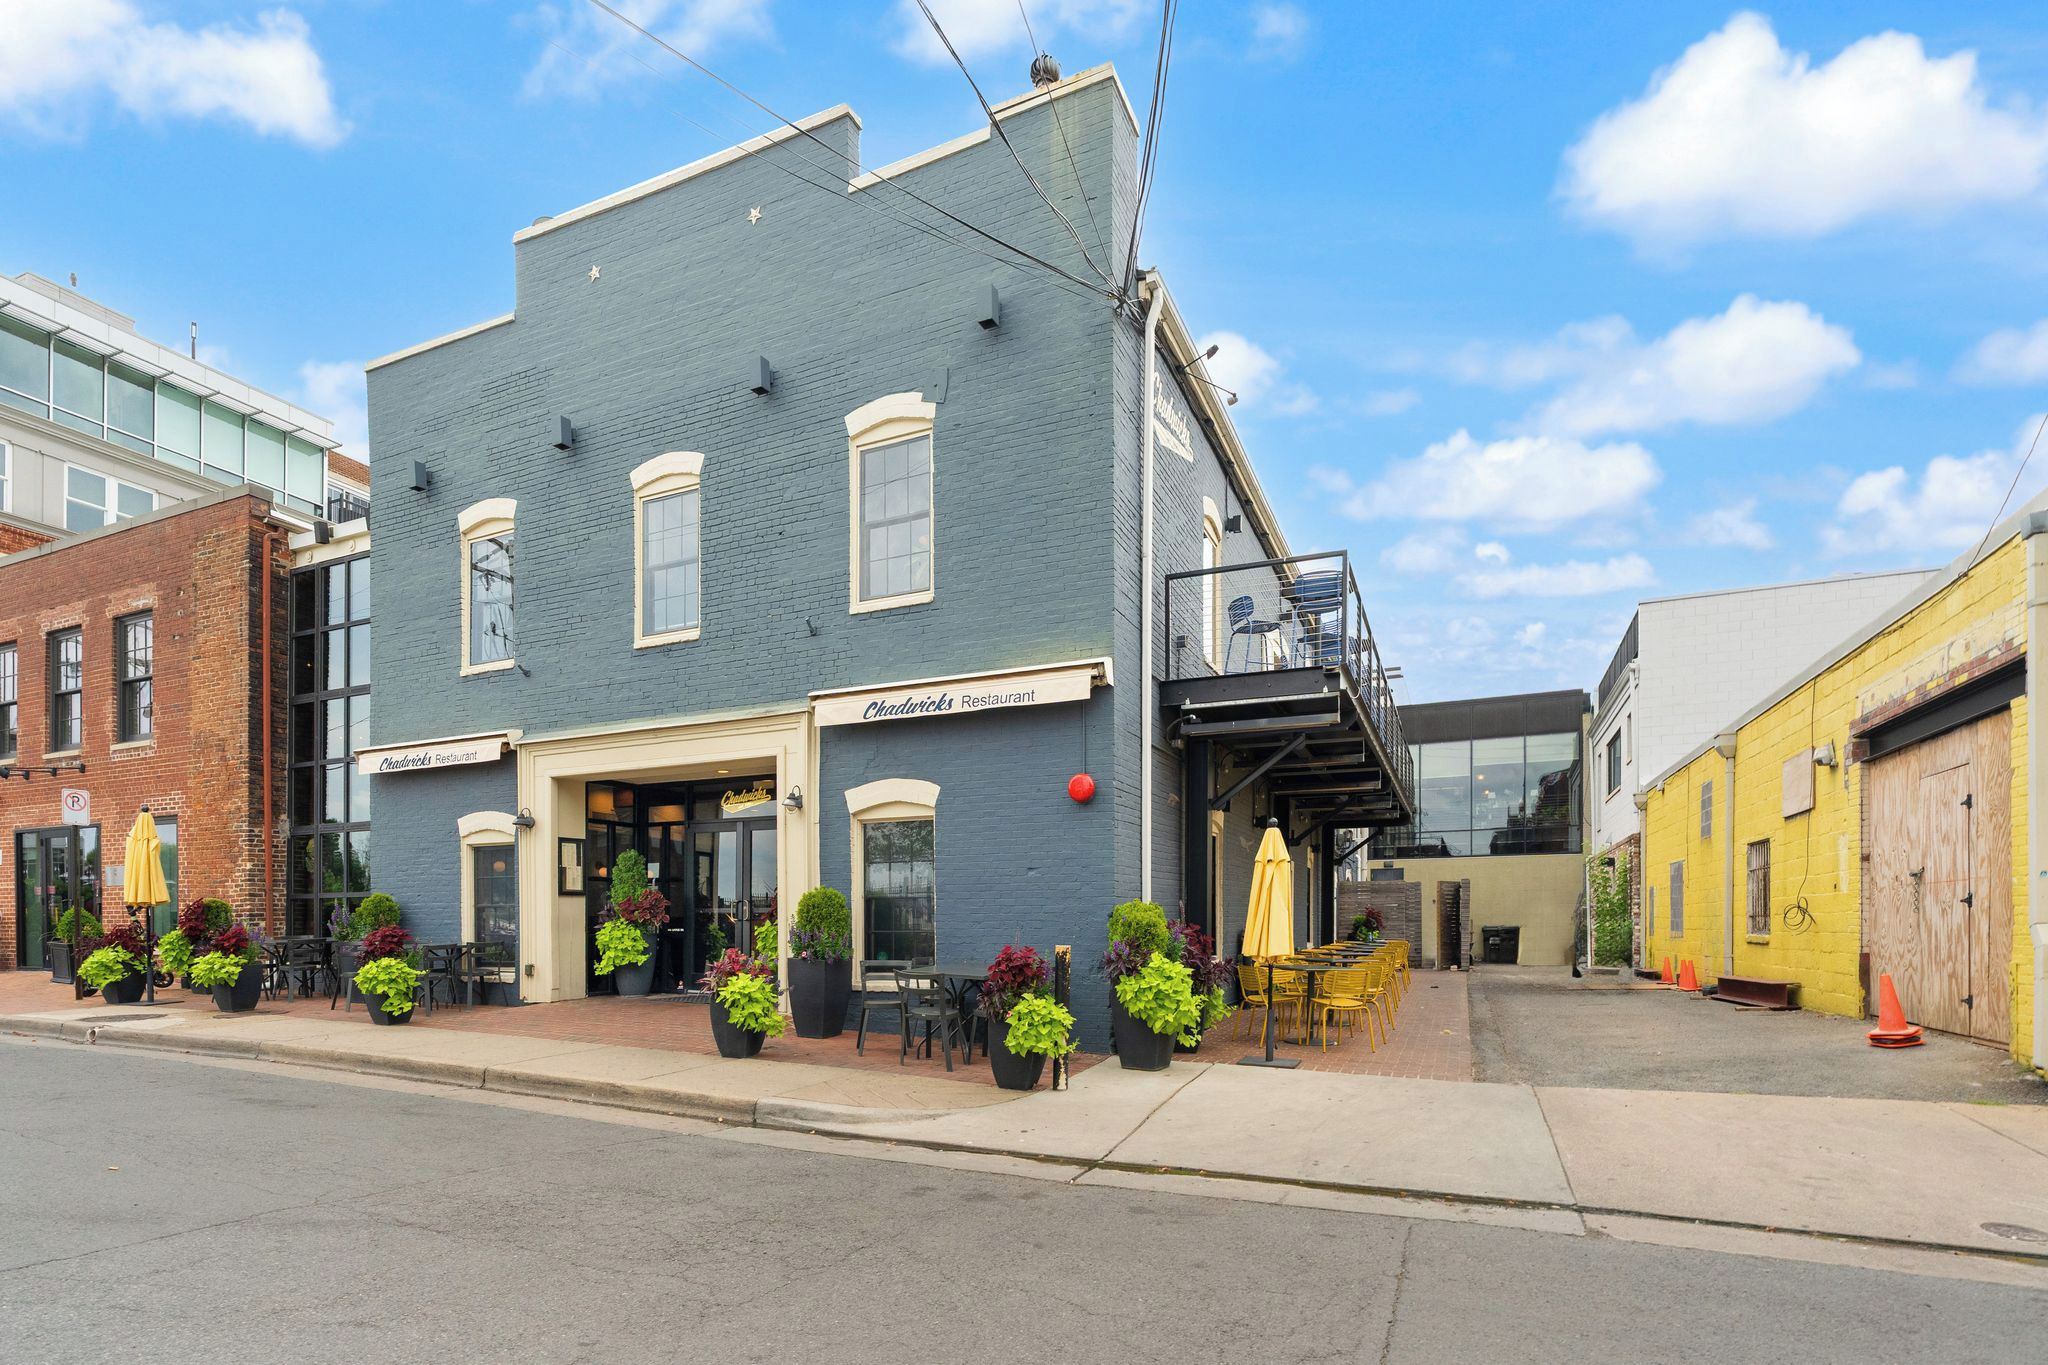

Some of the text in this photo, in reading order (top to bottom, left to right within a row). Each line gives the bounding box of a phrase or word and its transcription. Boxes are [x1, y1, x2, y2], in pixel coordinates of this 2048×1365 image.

[862, 689, 1036, 720] Chadwicks Restaurant
[379, 751, 477, 772] Chadwicks Restaurant
[720, 786, 767, 807] Chadwicks
